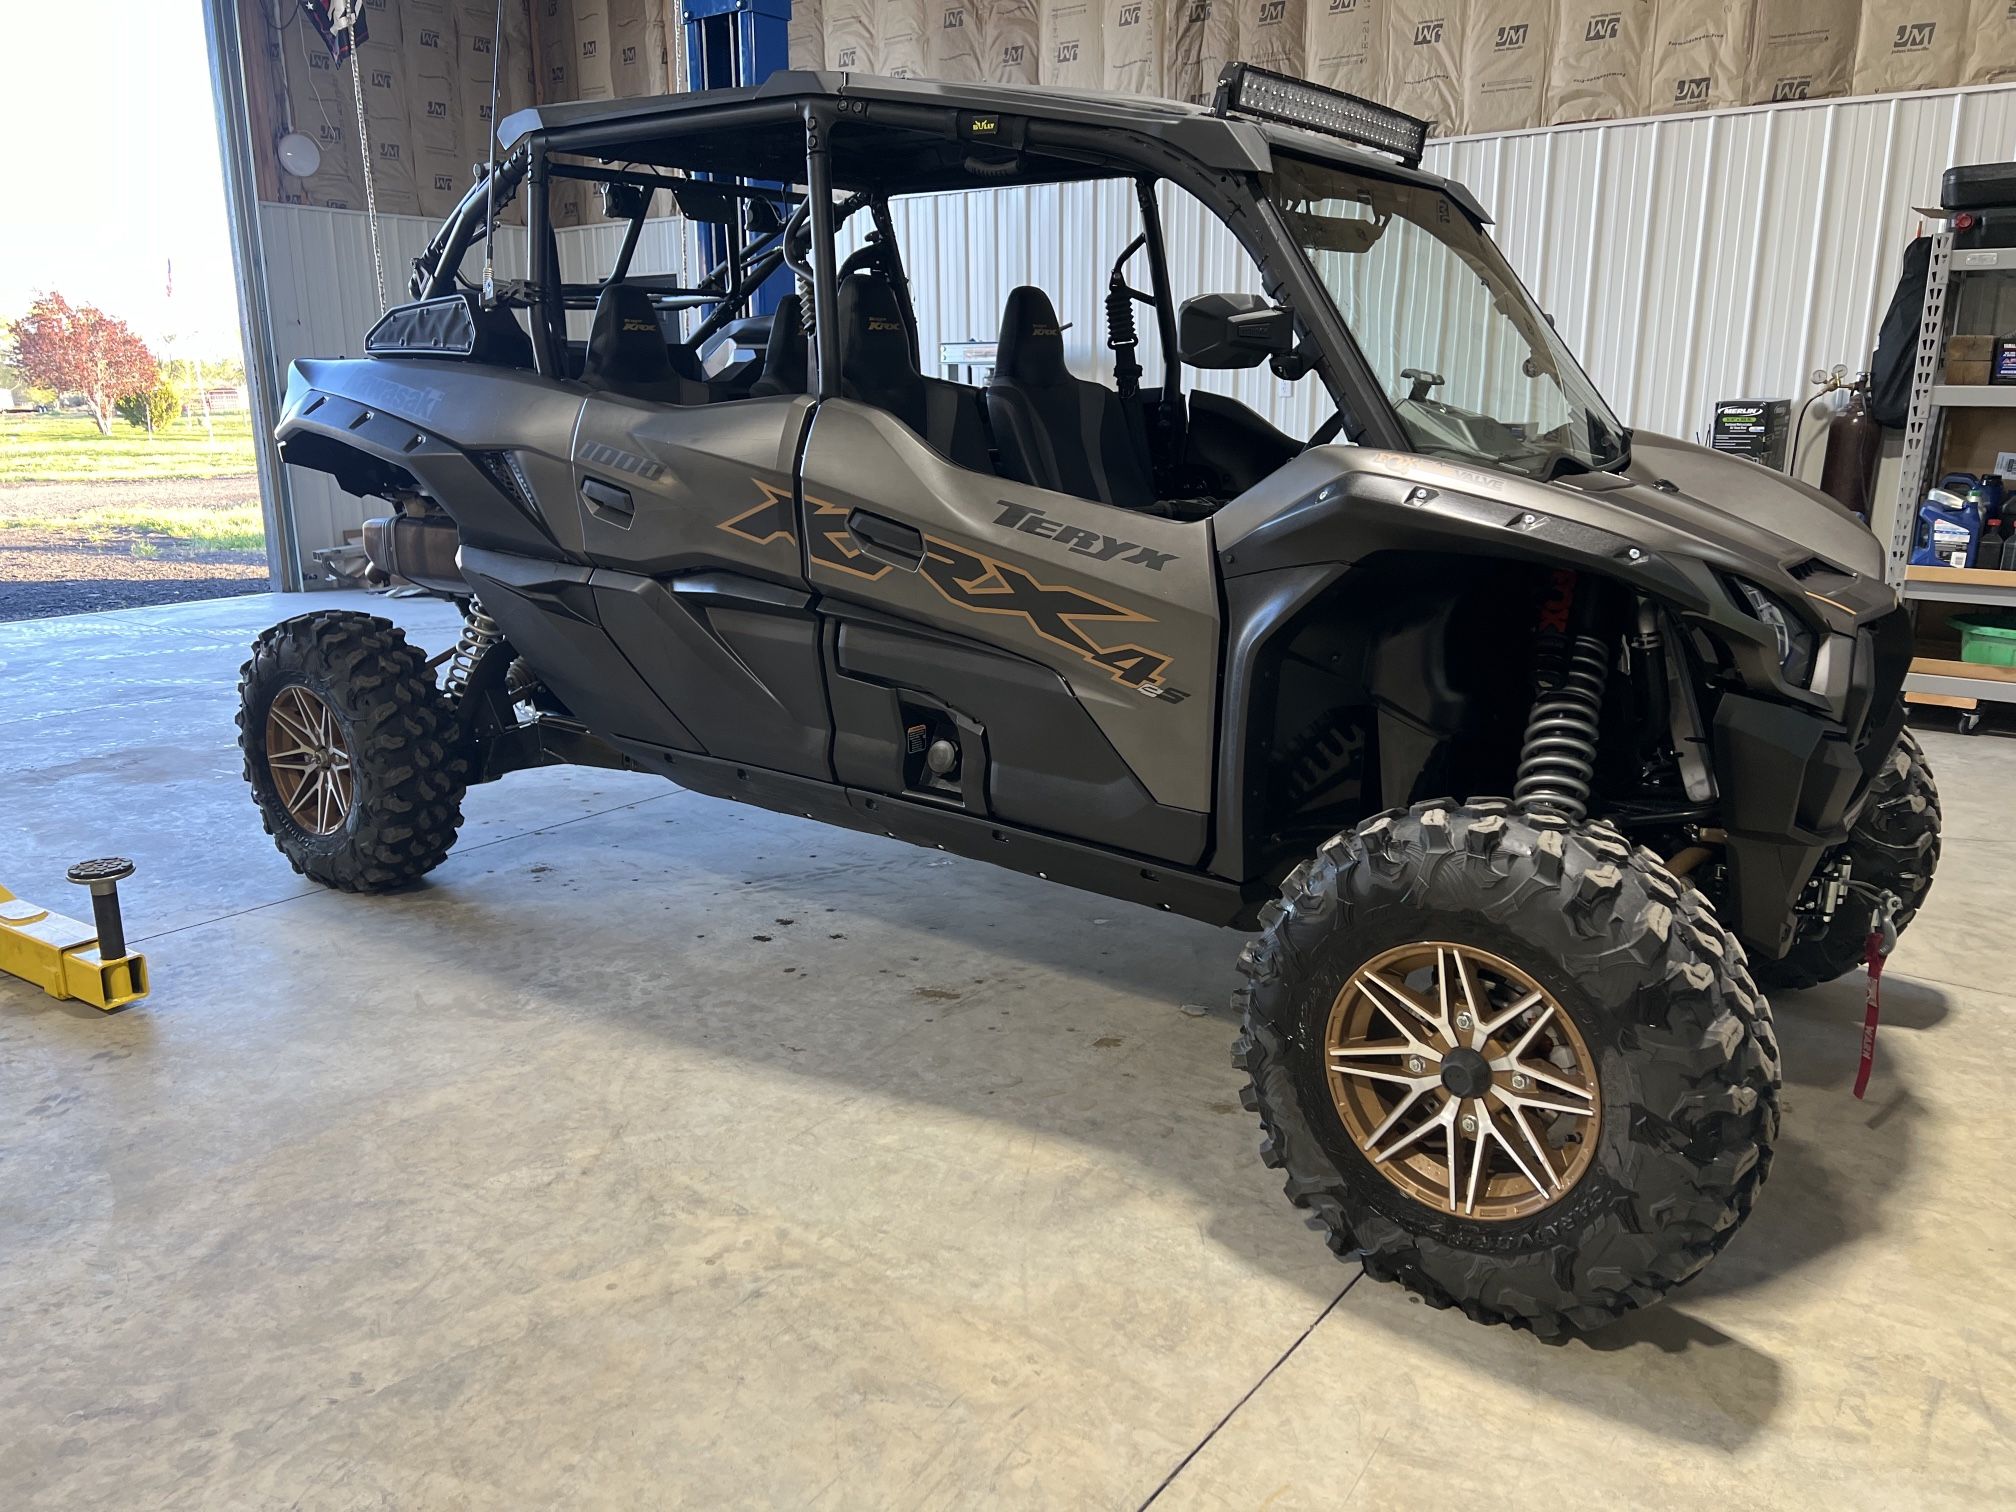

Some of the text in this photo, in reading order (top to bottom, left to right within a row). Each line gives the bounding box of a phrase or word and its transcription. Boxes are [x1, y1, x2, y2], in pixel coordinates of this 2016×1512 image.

[944, 10, 963, 29] JM
[1119, 6, 1141, 27] JM
[1259, 1, 1285, 22] JM
[1414, 24, 1443, 45] JM
[1495, 24, 1528, 47] JM
[1585, 17, 1621, 41] JM
[1893, 22, 1936, 48] JM
[420, 31, 440, 48] JM
[583, 41, 596, 55] JM
[839, 51, 856, 68] JM
[1002, 45, 1024, 63] JM
[1057, 44, 1079, 63] JM
[1675, 77, 1711, 101] JM
[1772, 81, 1810, 102] JM
[427, 101, 447, 116] JM
[972, 119, 995, 131] BULLY
[380, 143, 399, 158] JM
[622, 323, 657, 332] KRX
[868, 322, 900, 331] KRX
[1723, 407, 1758, 415] MERLIN
[579, 440, 666, 481] 1000
[1454, 469, 1505, 491] VALVE
[992, 499, 1181, 572] TERYX
[1862, 1025, 1875, 1060] WARN
